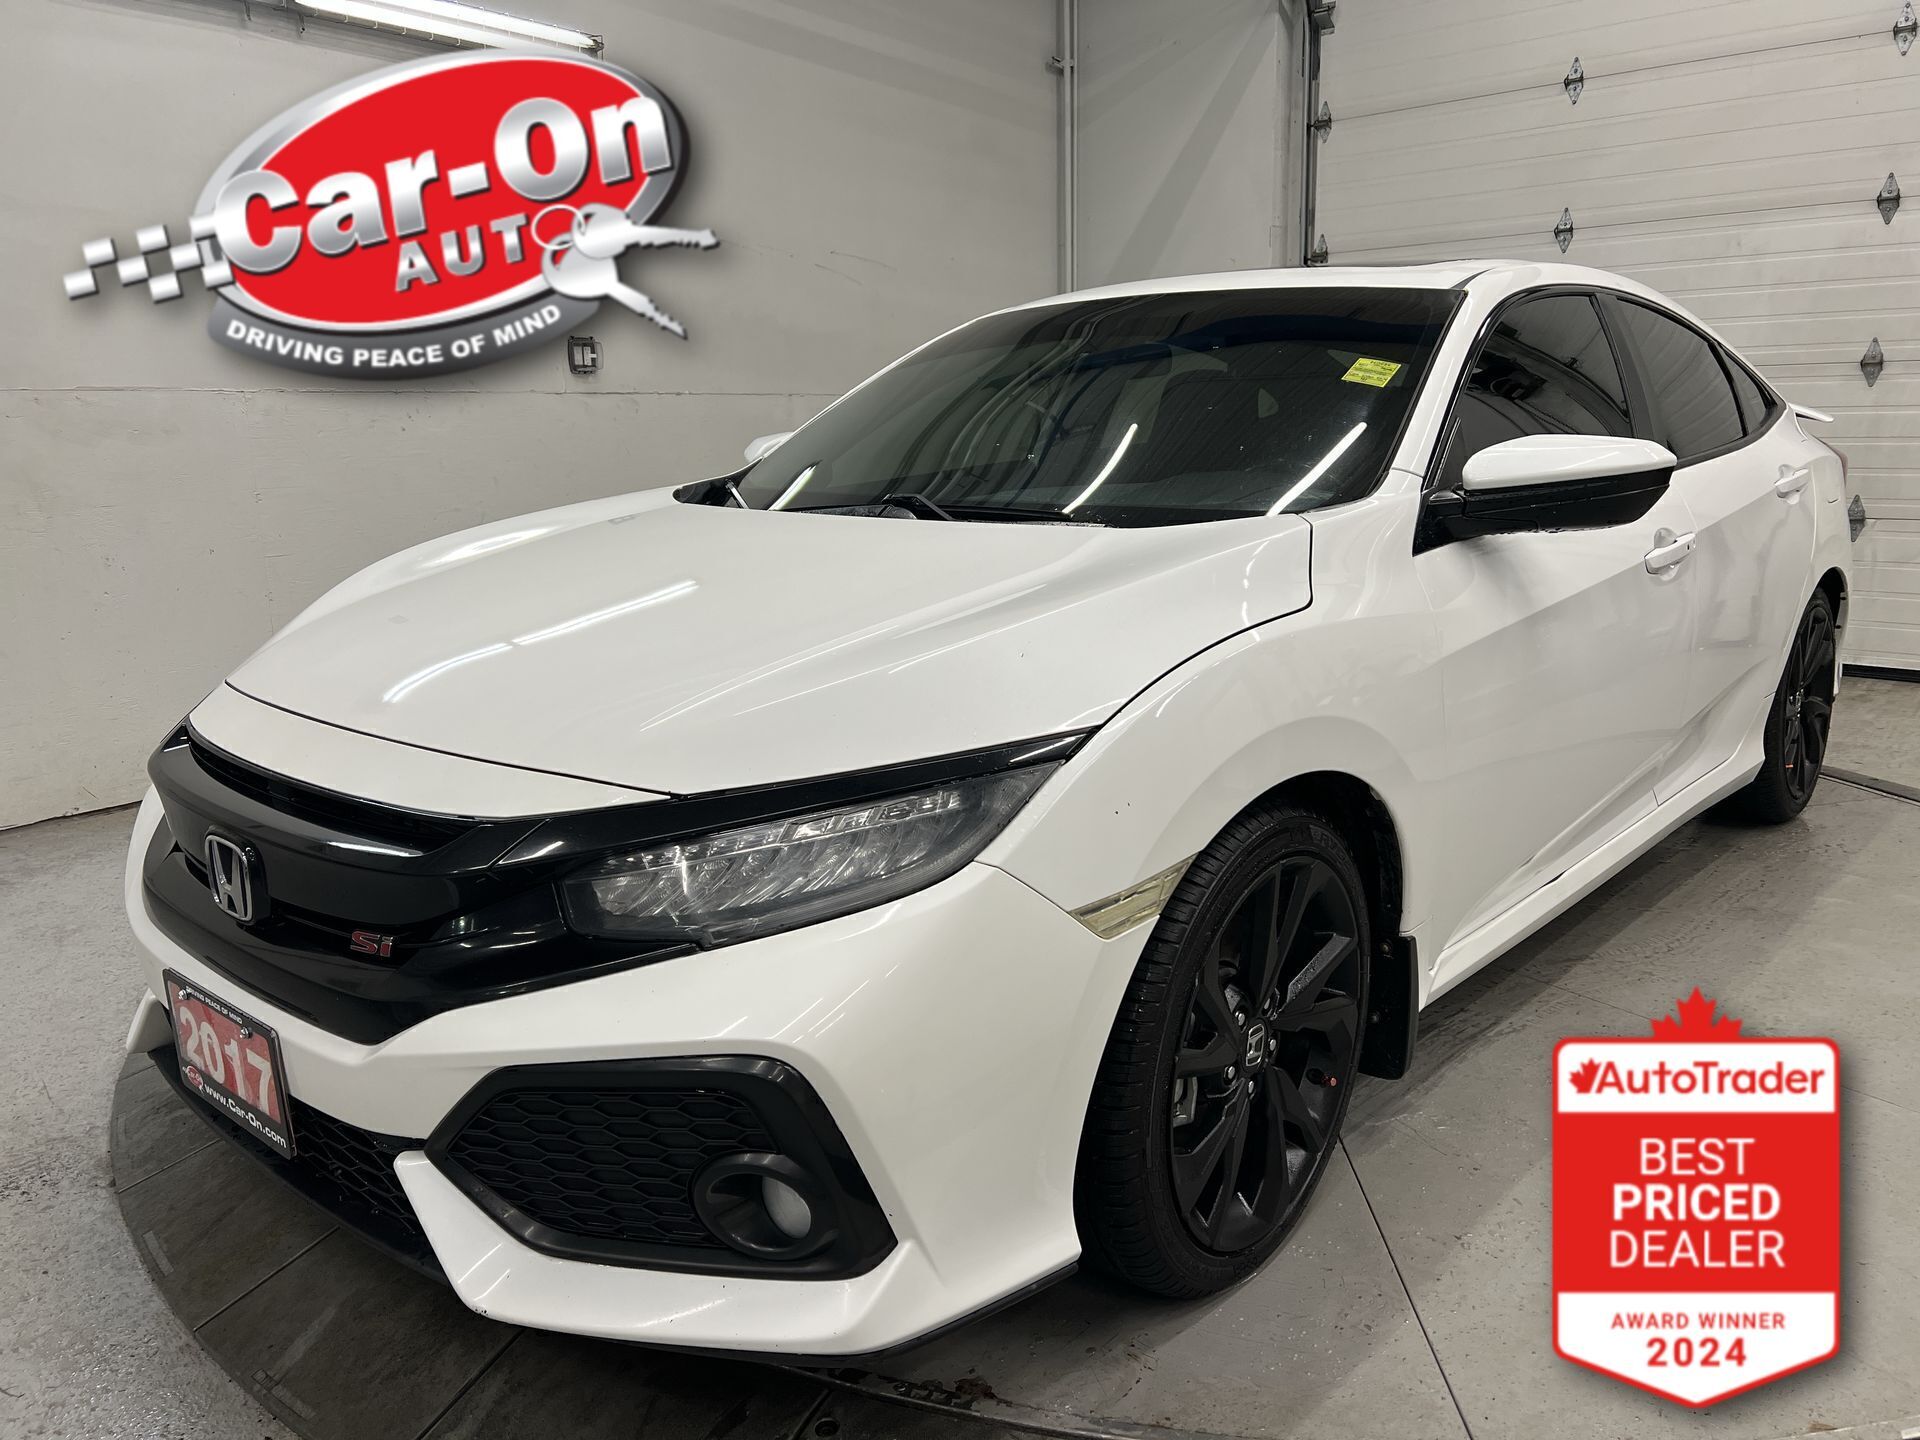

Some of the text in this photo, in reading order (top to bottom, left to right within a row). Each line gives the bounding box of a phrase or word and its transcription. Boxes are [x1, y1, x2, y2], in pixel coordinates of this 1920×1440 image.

[351, 931, 394, 957] Si
[179, 1006, 272, 1116] 2017
[204, 1083, 288, 1149] www.Car-On.com
